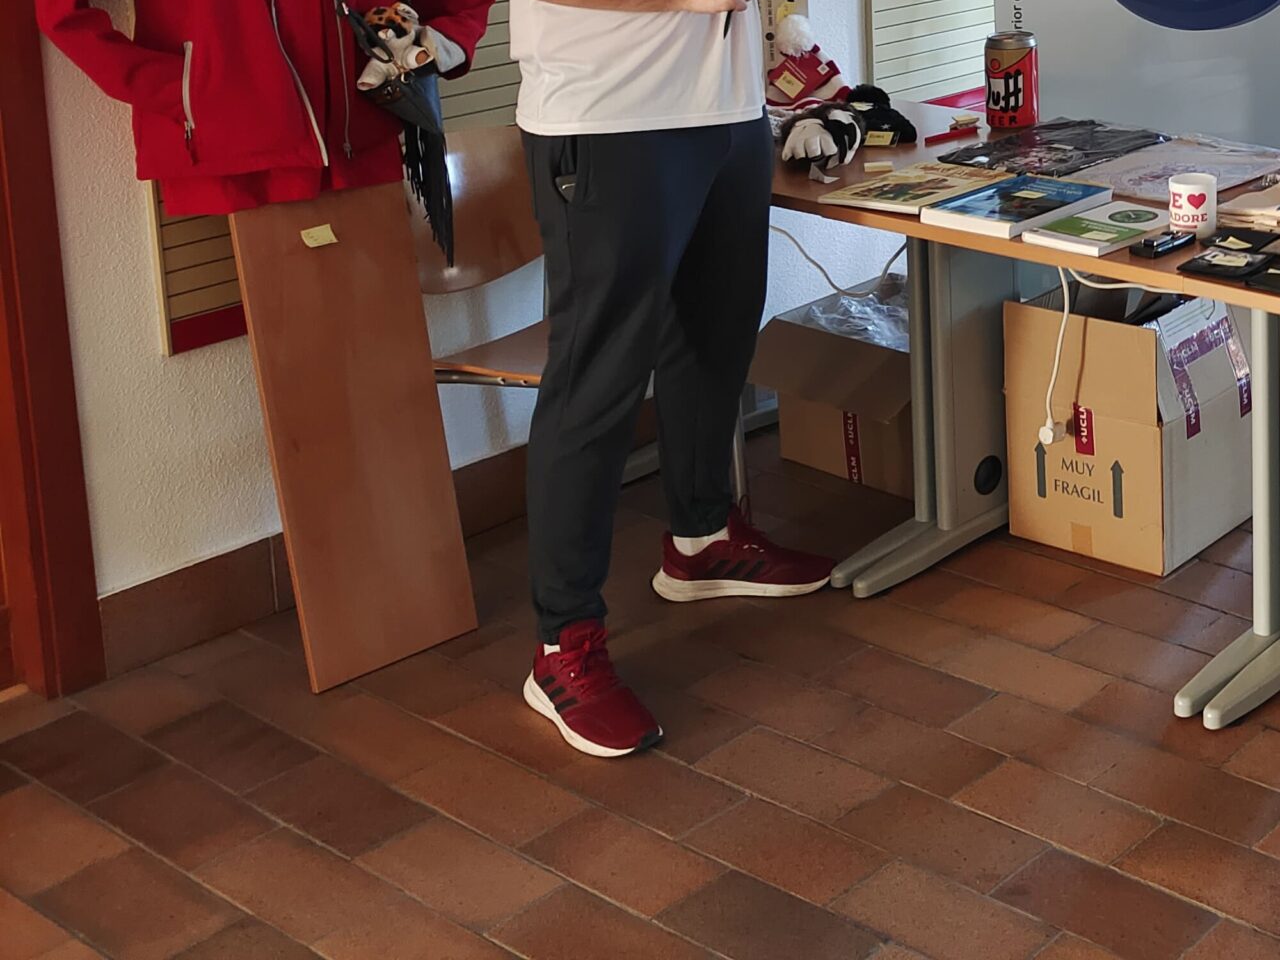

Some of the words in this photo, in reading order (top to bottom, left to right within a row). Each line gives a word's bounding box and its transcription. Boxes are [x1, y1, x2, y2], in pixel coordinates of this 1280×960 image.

[1012, 5, 1023, 32] rior
[1061, 456, 1096, 477] MUY
[1054, 478, 1104, 504] FRAGIL
